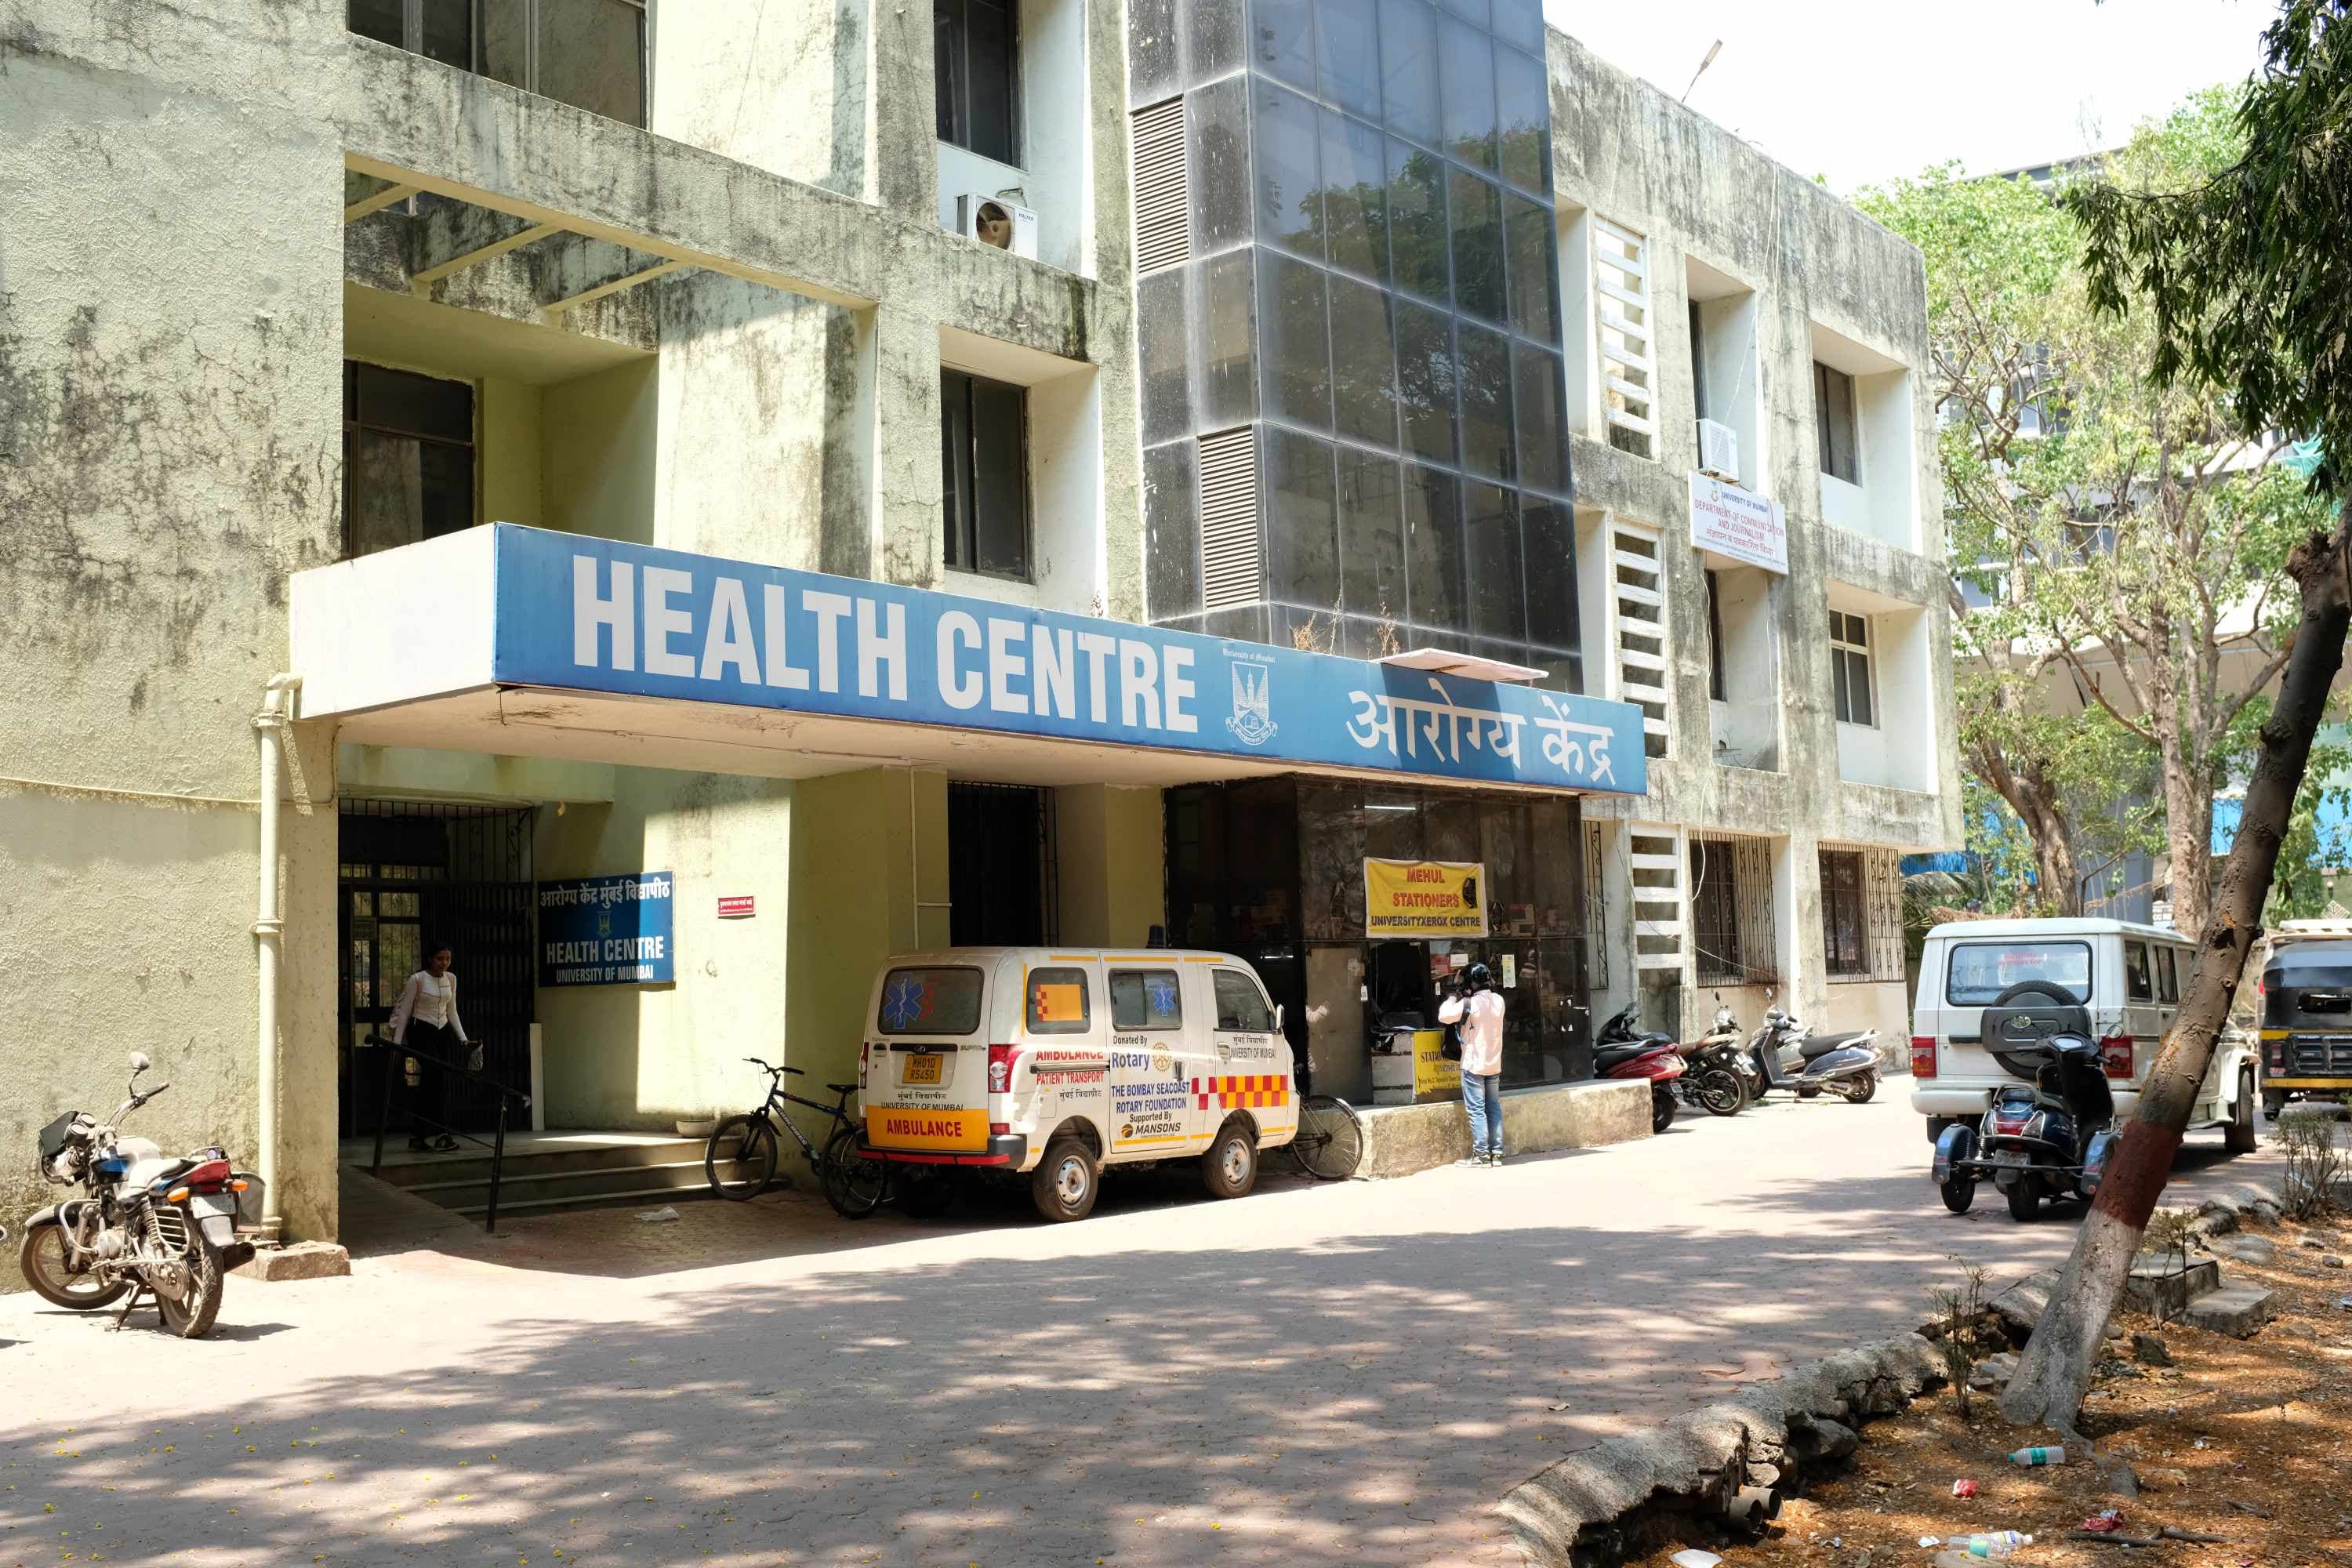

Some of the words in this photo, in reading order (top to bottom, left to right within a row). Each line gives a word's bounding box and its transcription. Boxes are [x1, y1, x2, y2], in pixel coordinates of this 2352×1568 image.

[1722, 492, 1746, 505] UNIVERSITY
[1694, 499, 1731, 518] DEPARTMENT
[1732, 511, 1739, 521] OF
[1718, 518, 1730, 530] AND
[1730, 522, 1764, 540] JOURNALISM
[573, 554, 908, 702] HEALTH
[936, 610, 1198, 733] CENTRE
[1345, 677, 1527, 770] आरोग्य
[1533, 695, 1616, 786] केंद्र
[1406, 868, 1446, 884] MEHUL
[540, 884, 578, 906] आरोग्य
[580, 882, 597, 904] केंद्र
[600, 879, 623, 909] मुंबई
[625, 877, 670, 901] विद्यापीठ
[1392, 891, 1460, 908] STATIONERS
[1450, 916, 1481, 927] CENTRE
[546, 940, 599, 964] HEALTH
[604, 935, 664, 962] CENTRE
[556, 966, 602, 983] UNIVERSITY
[605, 967, 615, 980] OF
[617, 964, 654, 980] MUMBAI
[1112, 1035, 1138, 1045] Donated
[1139, 1035, 1148, 1047] By
[1229, 1047, 1253, 1058] UNIVERSITY
[1254, 1047, 1259, 1058] OF
[1260, 1047, 1276, 1058] MUMBAI
[1112, 1052, 1150, 1072] Rotary
[1036, 1072, 1064, 1086] PATIENT
[1065, 1071, 1105, 1085] TRANSPORT
[1059, 1087, 1074, 1102] मुंबई
[1111, 1085, 1125, 1098] THE
[1127, 1083, 1155, 1097] BOMBAY
[1156, 1081, 1190, 1094] SEACOAST
[880, 1102, 920, 1110] UNIVERSITY
[932, 1103, 964, 1112] MUMBAI
[1116, 1099, 1144, 1114] ROTARY
[1145, 1097, 1187, 1112] FOUNDATION
[1129, 1112, 1163, 1124] Supported
[1164, 1110, 1172, 1122] By
[887, 1119, 963, 1138] AMBULANCE
[1135, 1122, 1181, 1135] MANSONS
